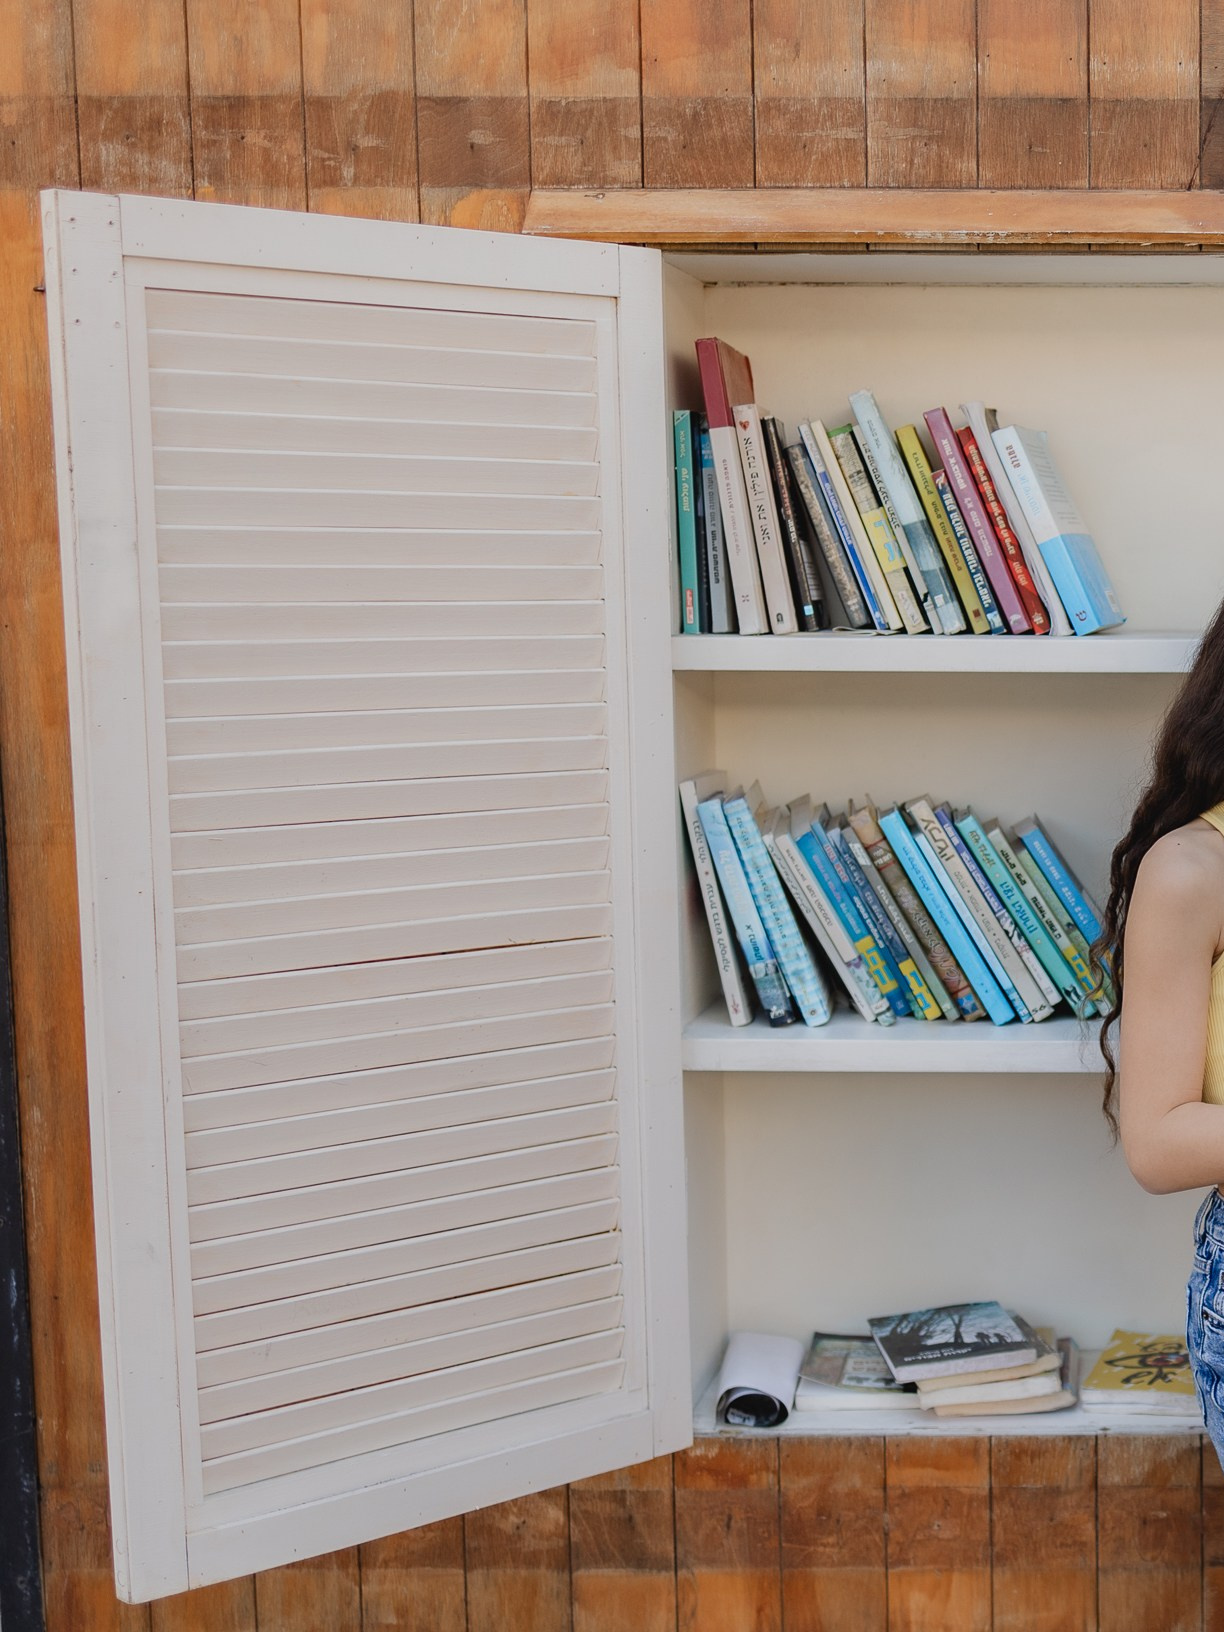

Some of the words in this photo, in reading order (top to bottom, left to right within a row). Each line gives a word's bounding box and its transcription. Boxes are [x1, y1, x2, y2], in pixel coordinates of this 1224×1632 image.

[743, 437, 756, 468] אורנה
[748, 471, 764, 495] פילין
[755, 503, 766, 520] את
[878, 486, 890, 504] לעבר
[885, 505, 900, 529] הצלוב
[941, 492, 956, 511] עמק
[962, 496, 973, 508] לא
[969, 509, 981, 527] סתם
[759, 523, 770, 544] ואני
[691, 819, 704, 844] רבקה
[704, 883, 717, 909] עברית
[711, 912, 723, 934] בדגש
[1010, 899, 1037, 934] האחרון
